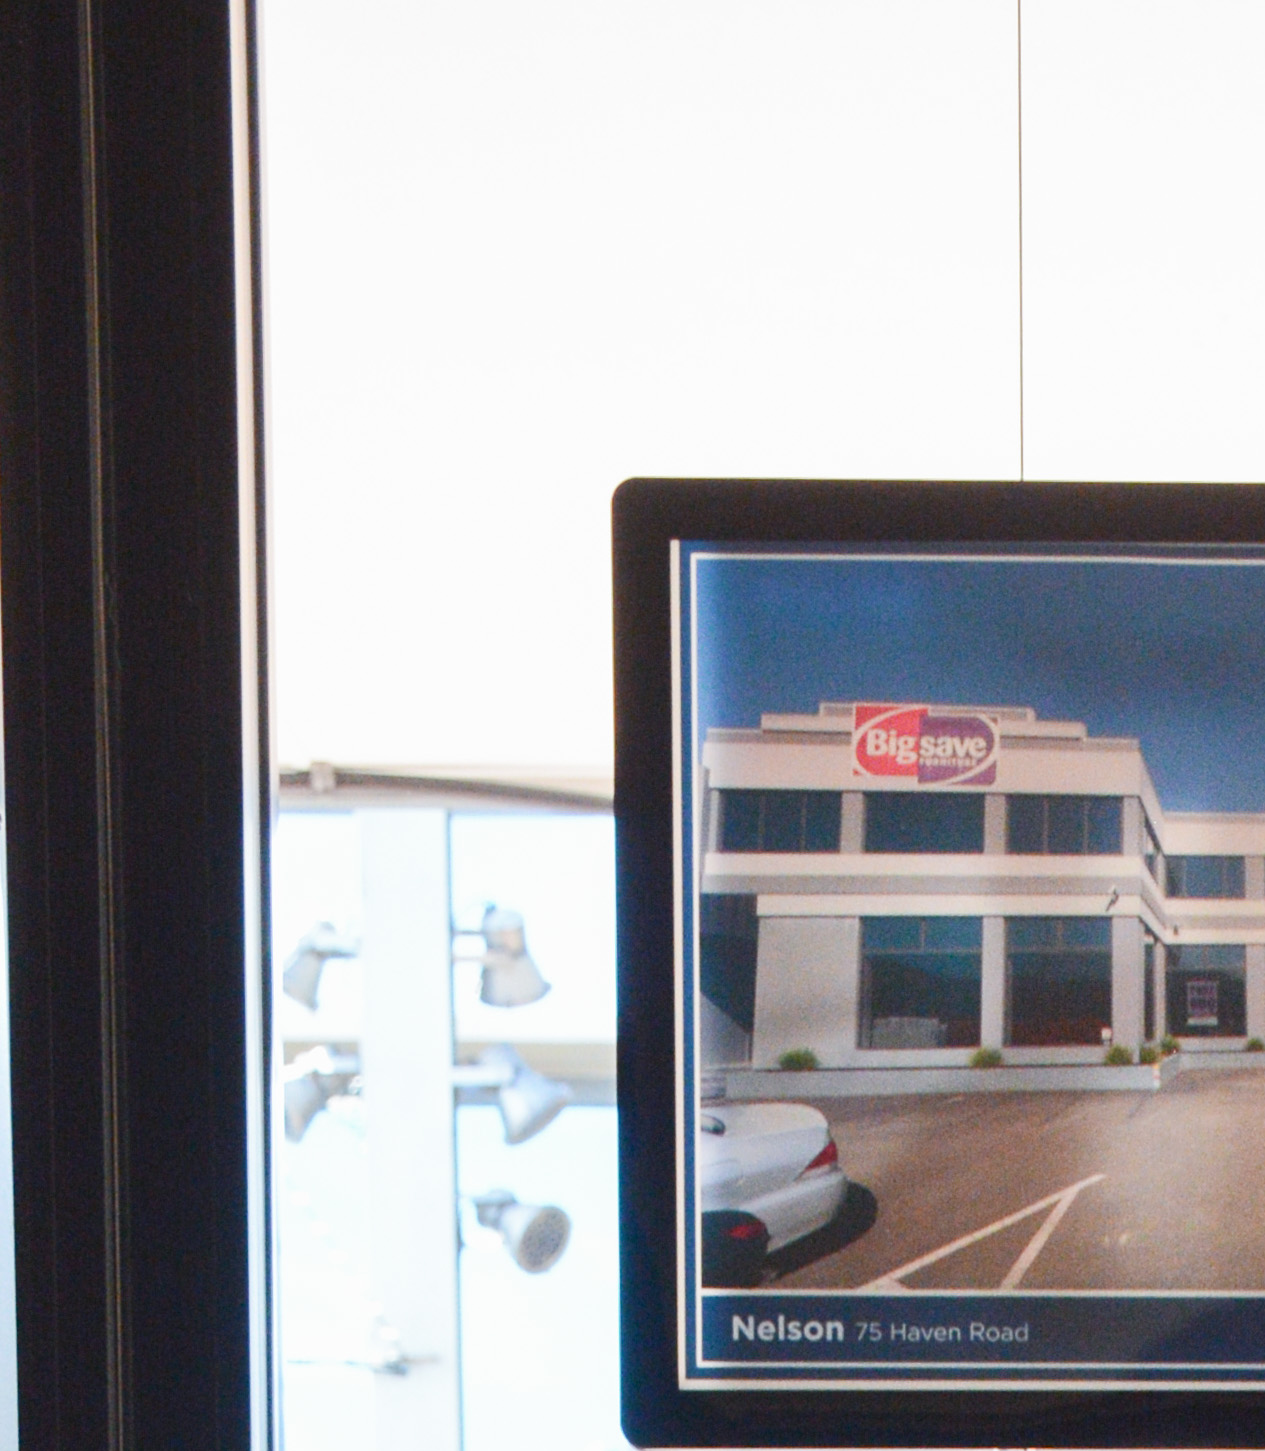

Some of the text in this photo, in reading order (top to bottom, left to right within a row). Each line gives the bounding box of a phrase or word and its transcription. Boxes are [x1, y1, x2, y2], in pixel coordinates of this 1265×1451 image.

[866, 728, 987, 765] Big save
[732, 1314, 1030, 1342] Nelson 75 Haven Road
